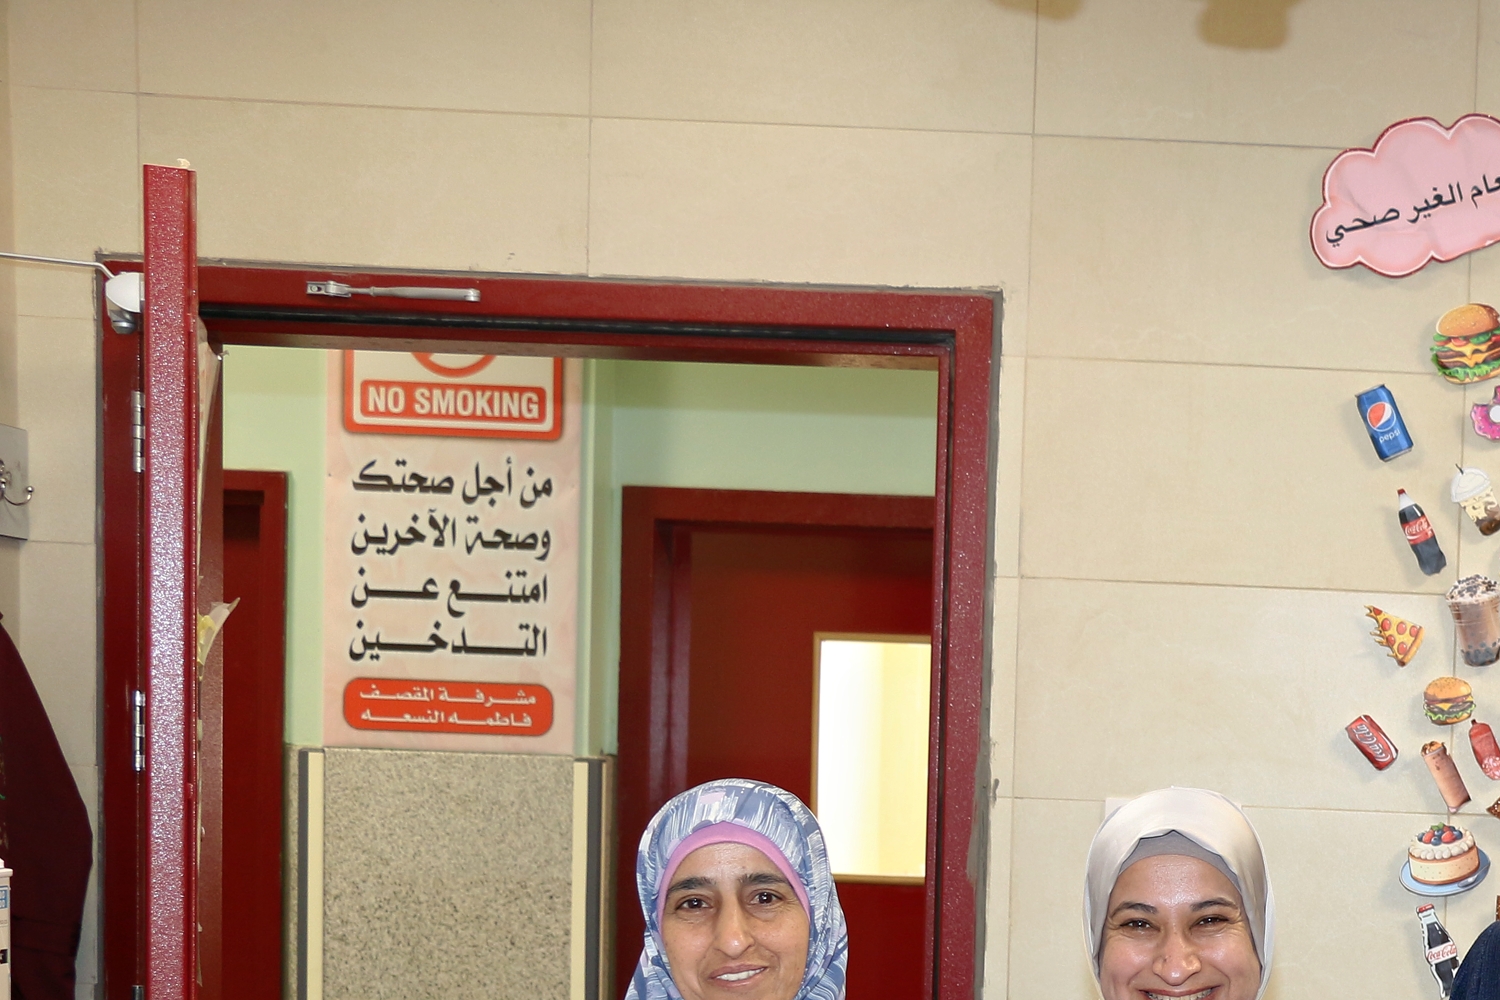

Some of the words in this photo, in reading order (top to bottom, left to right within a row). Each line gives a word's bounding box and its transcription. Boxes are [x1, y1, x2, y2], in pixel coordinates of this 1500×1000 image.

[1406, 182, 1463, 223] الغير
[1325, 206, 1400, 248] صحي
[367, 385, 405, 414] NO
[414, 388, 540, 419] SMOKING
[1379, 428, 1401, 443] pepsi
[352, 458, 454, 494] صحتك
[462, 456, 512, 507] أجل
[519, 467, 553, 508] من
[351, 508, 456, 556] الآخرين
[465, 515, 551, 561] وصحة
[351, 566, 440, 608] عن
[447, 570, 547, 618] امتنع
[349, 619, 547, 662] التدخين
[360, 684, 434, 703] المقصف
[438, 683, 537, 707] مشرفة
